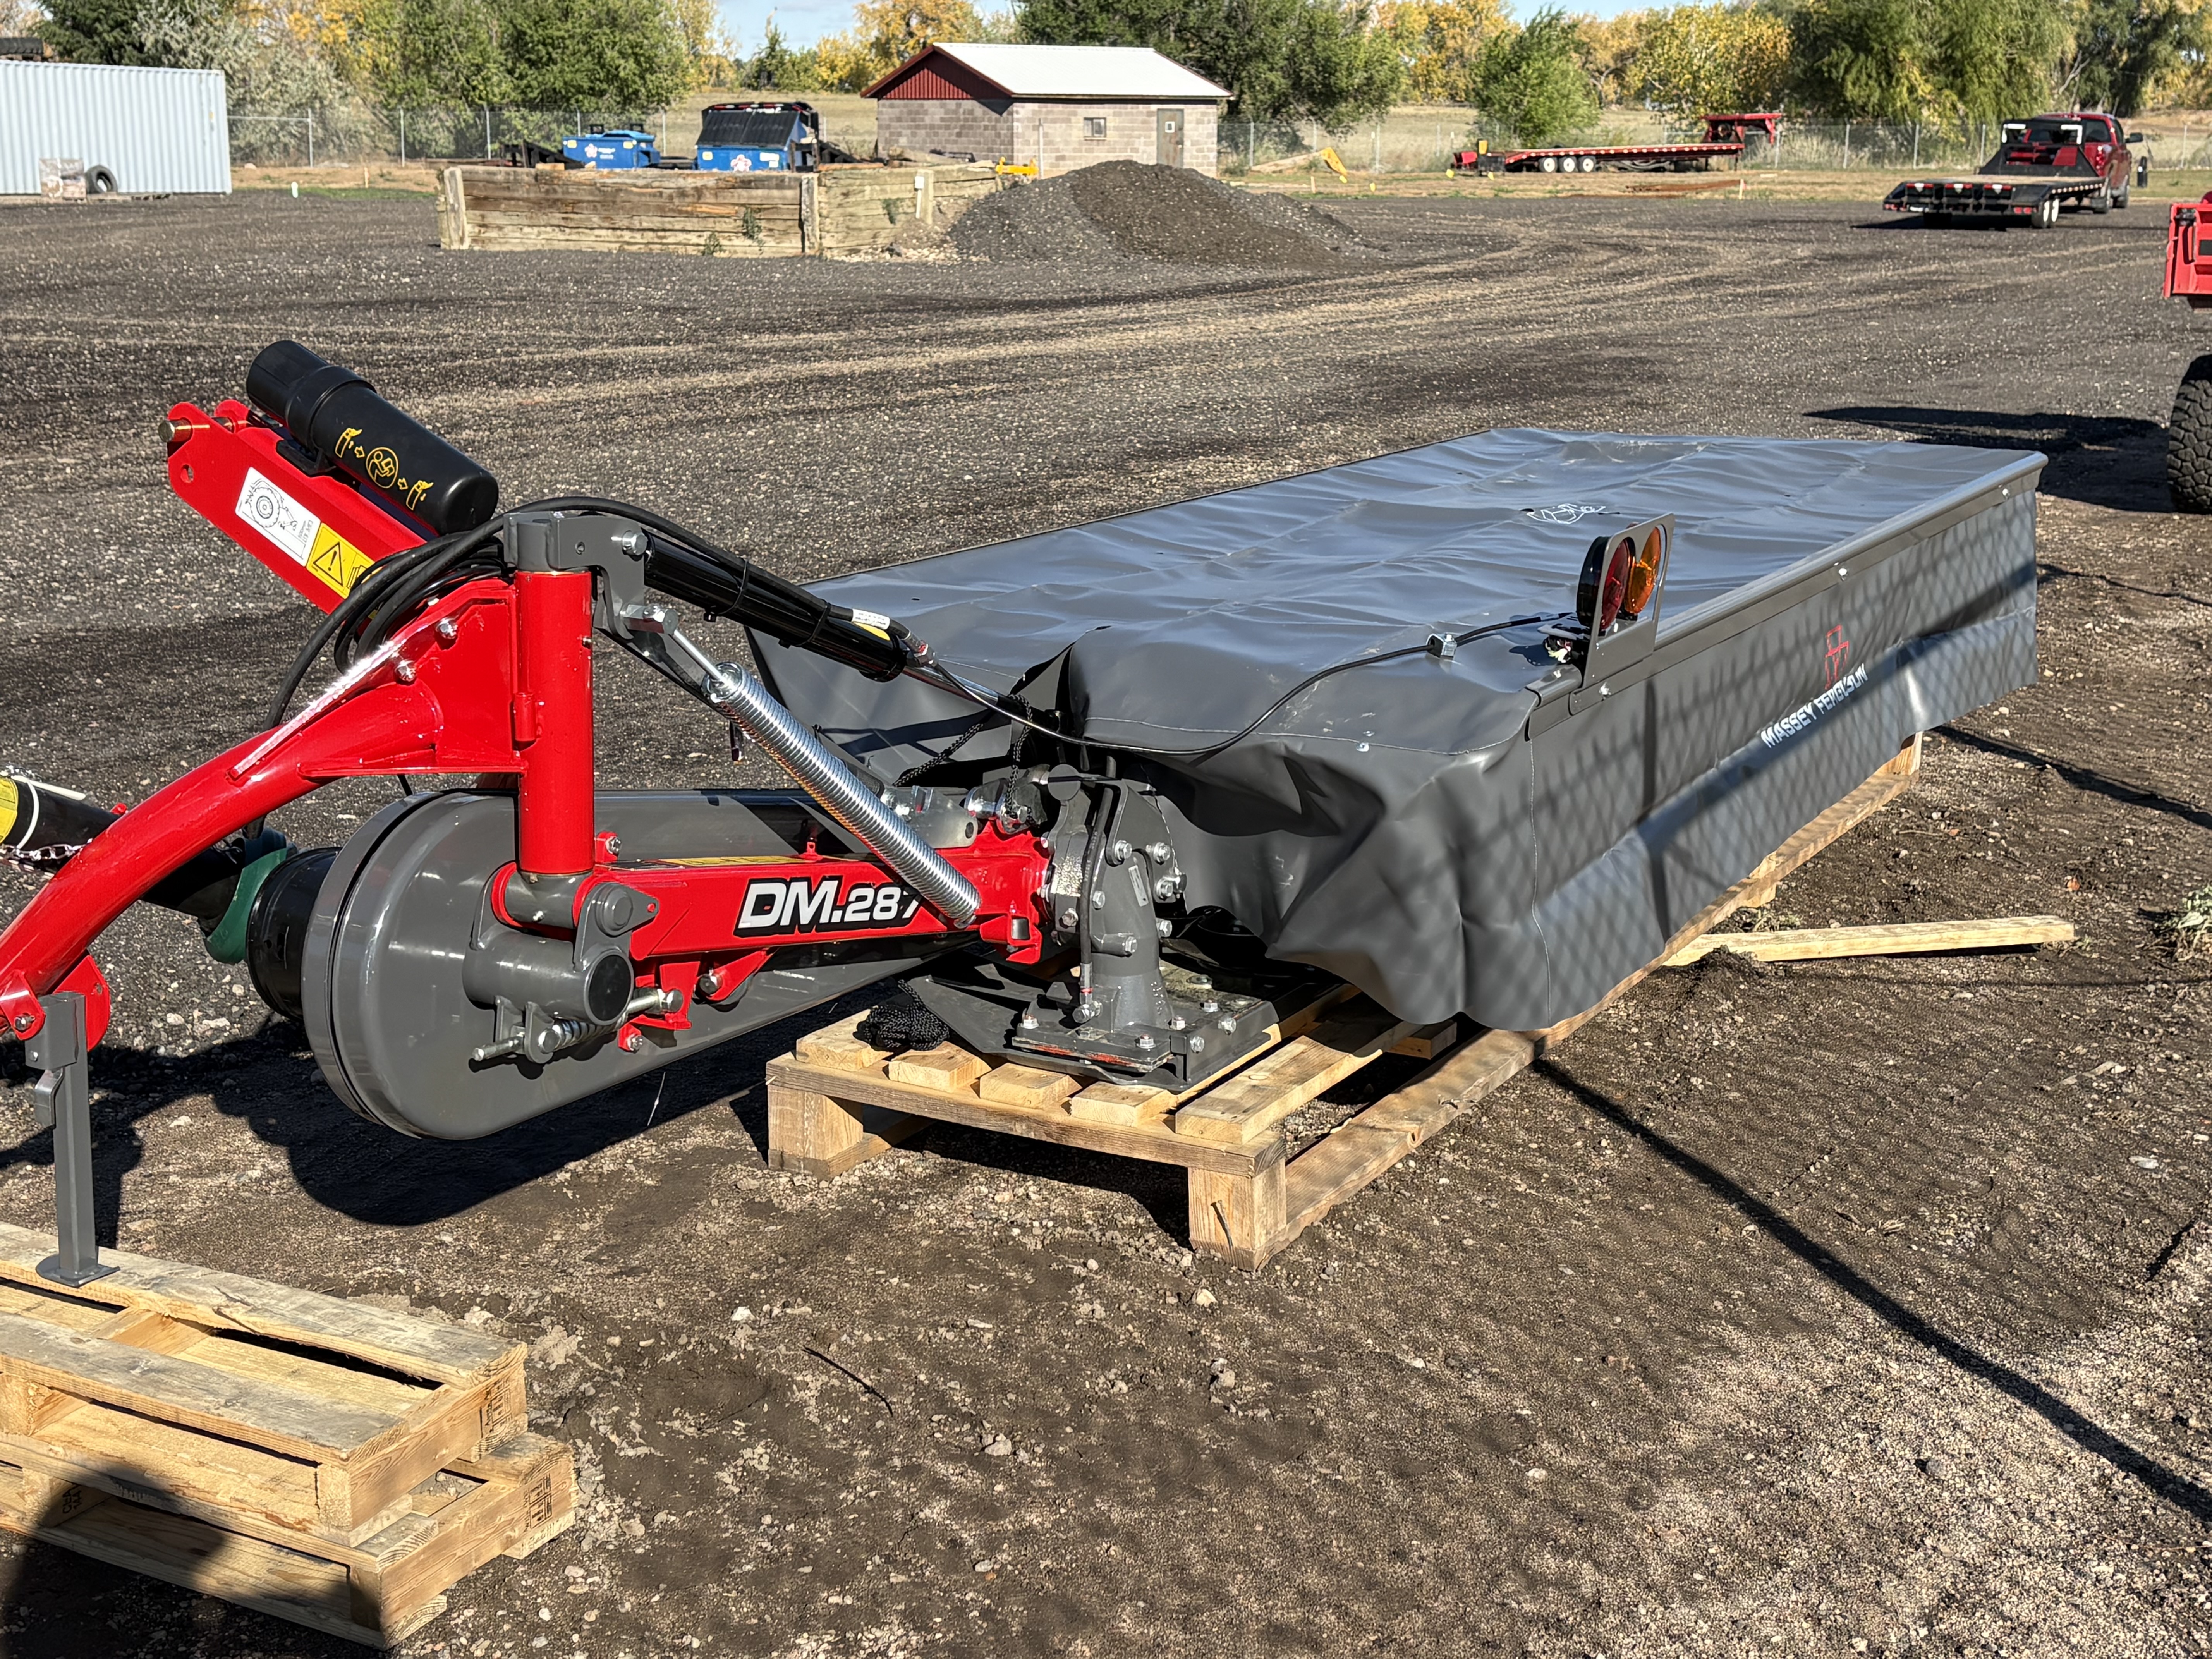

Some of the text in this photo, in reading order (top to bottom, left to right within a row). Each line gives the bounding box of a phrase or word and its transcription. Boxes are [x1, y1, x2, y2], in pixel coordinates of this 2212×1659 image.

[1761, 663, 1868, 748] MASSEY FERGUSON
[738, 880, 919, 928] DM.287
